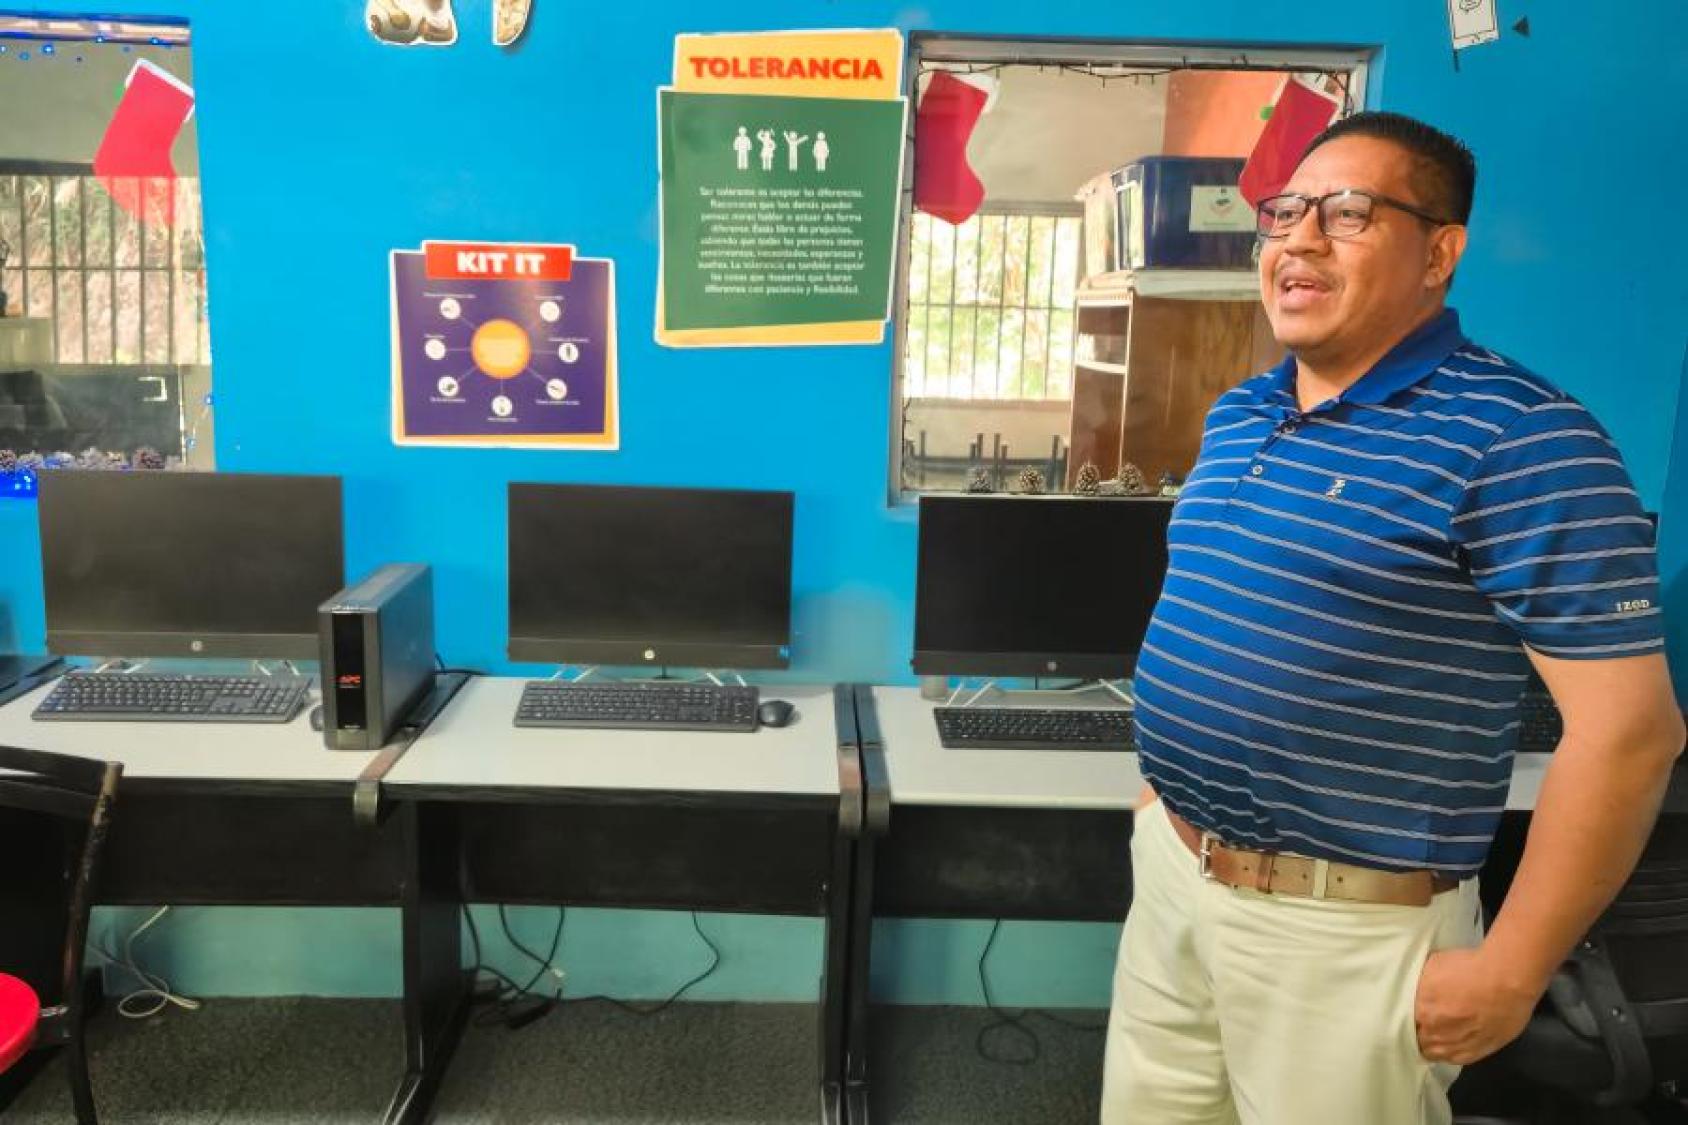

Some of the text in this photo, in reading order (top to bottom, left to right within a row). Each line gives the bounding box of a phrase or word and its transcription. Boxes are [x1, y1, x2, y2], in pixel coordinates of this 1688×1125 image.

[689, 56, 883, 80] TOLERANCIA
[456, 251, 546, 274] KIT IT
[1615, 599, 1650, 612] IZOD
